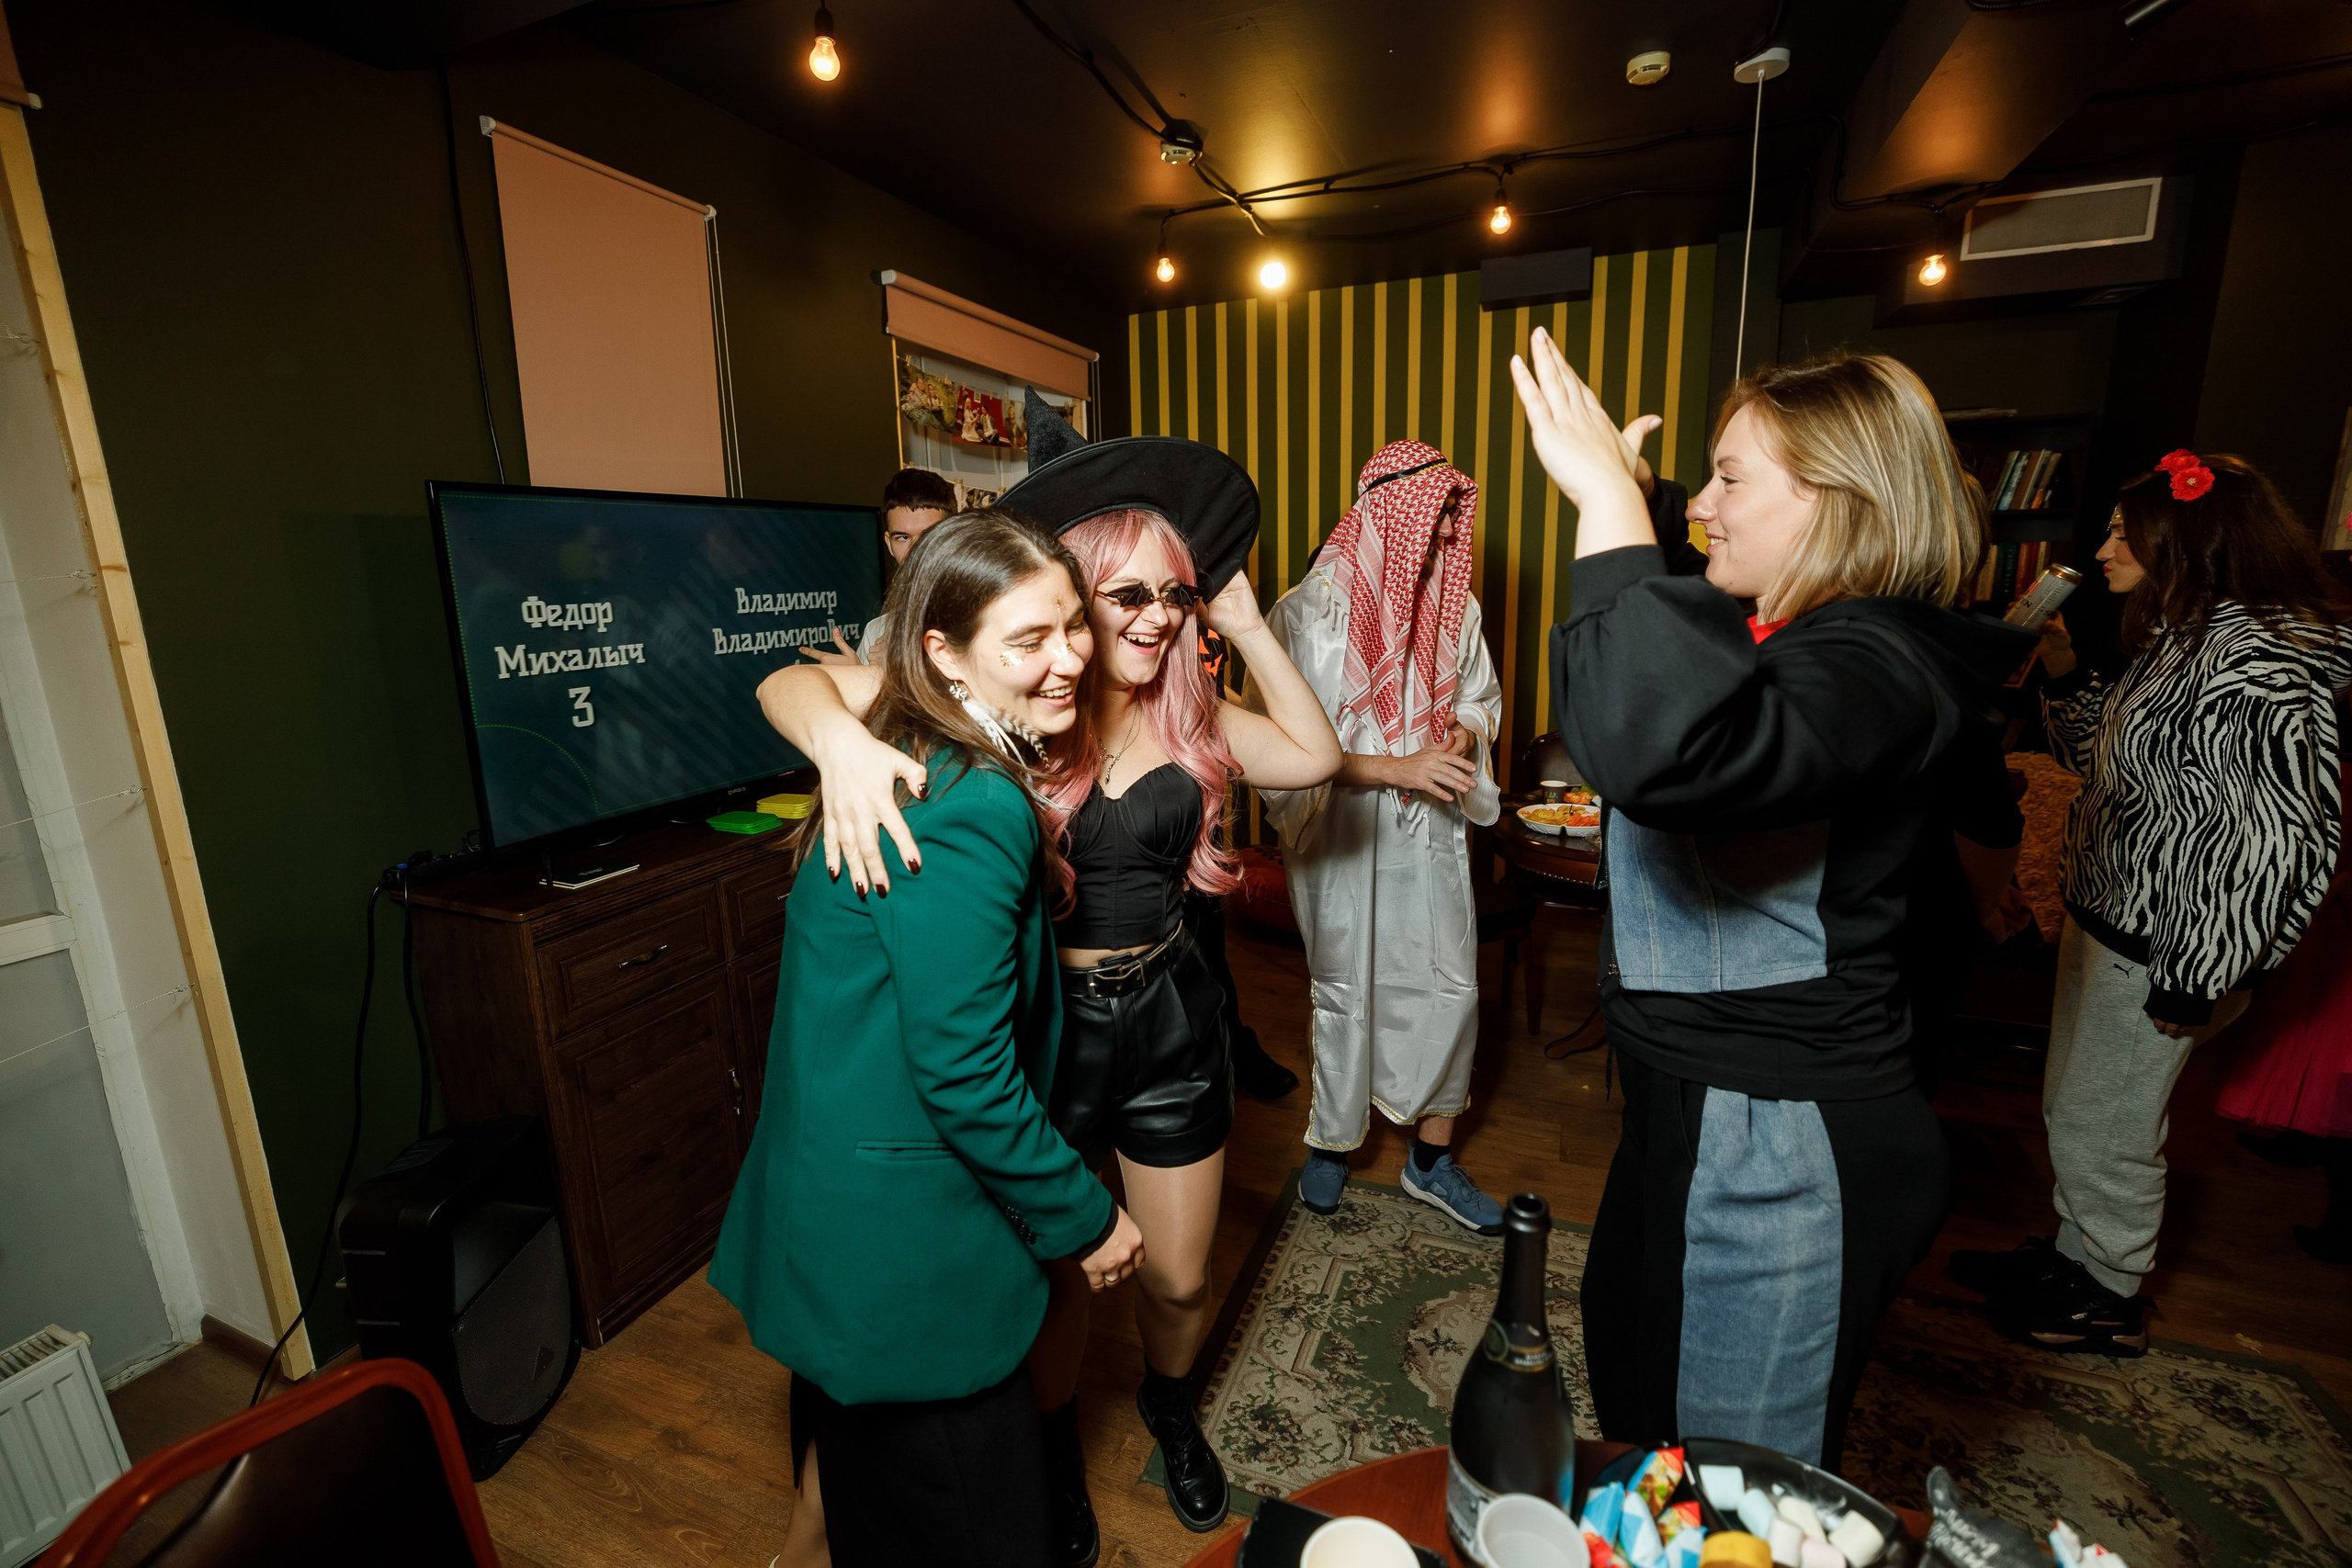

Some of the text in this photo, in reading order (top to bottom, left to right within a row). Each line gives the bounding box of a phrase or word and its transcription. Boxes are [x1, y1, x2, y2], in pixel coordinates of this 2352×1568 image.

[522, 595, 614, 632] Федор
[735, 587, 838, 616] Владимир
[494, 642, 646, 680] Михалыч
[568, 686, 594, 728] 3
